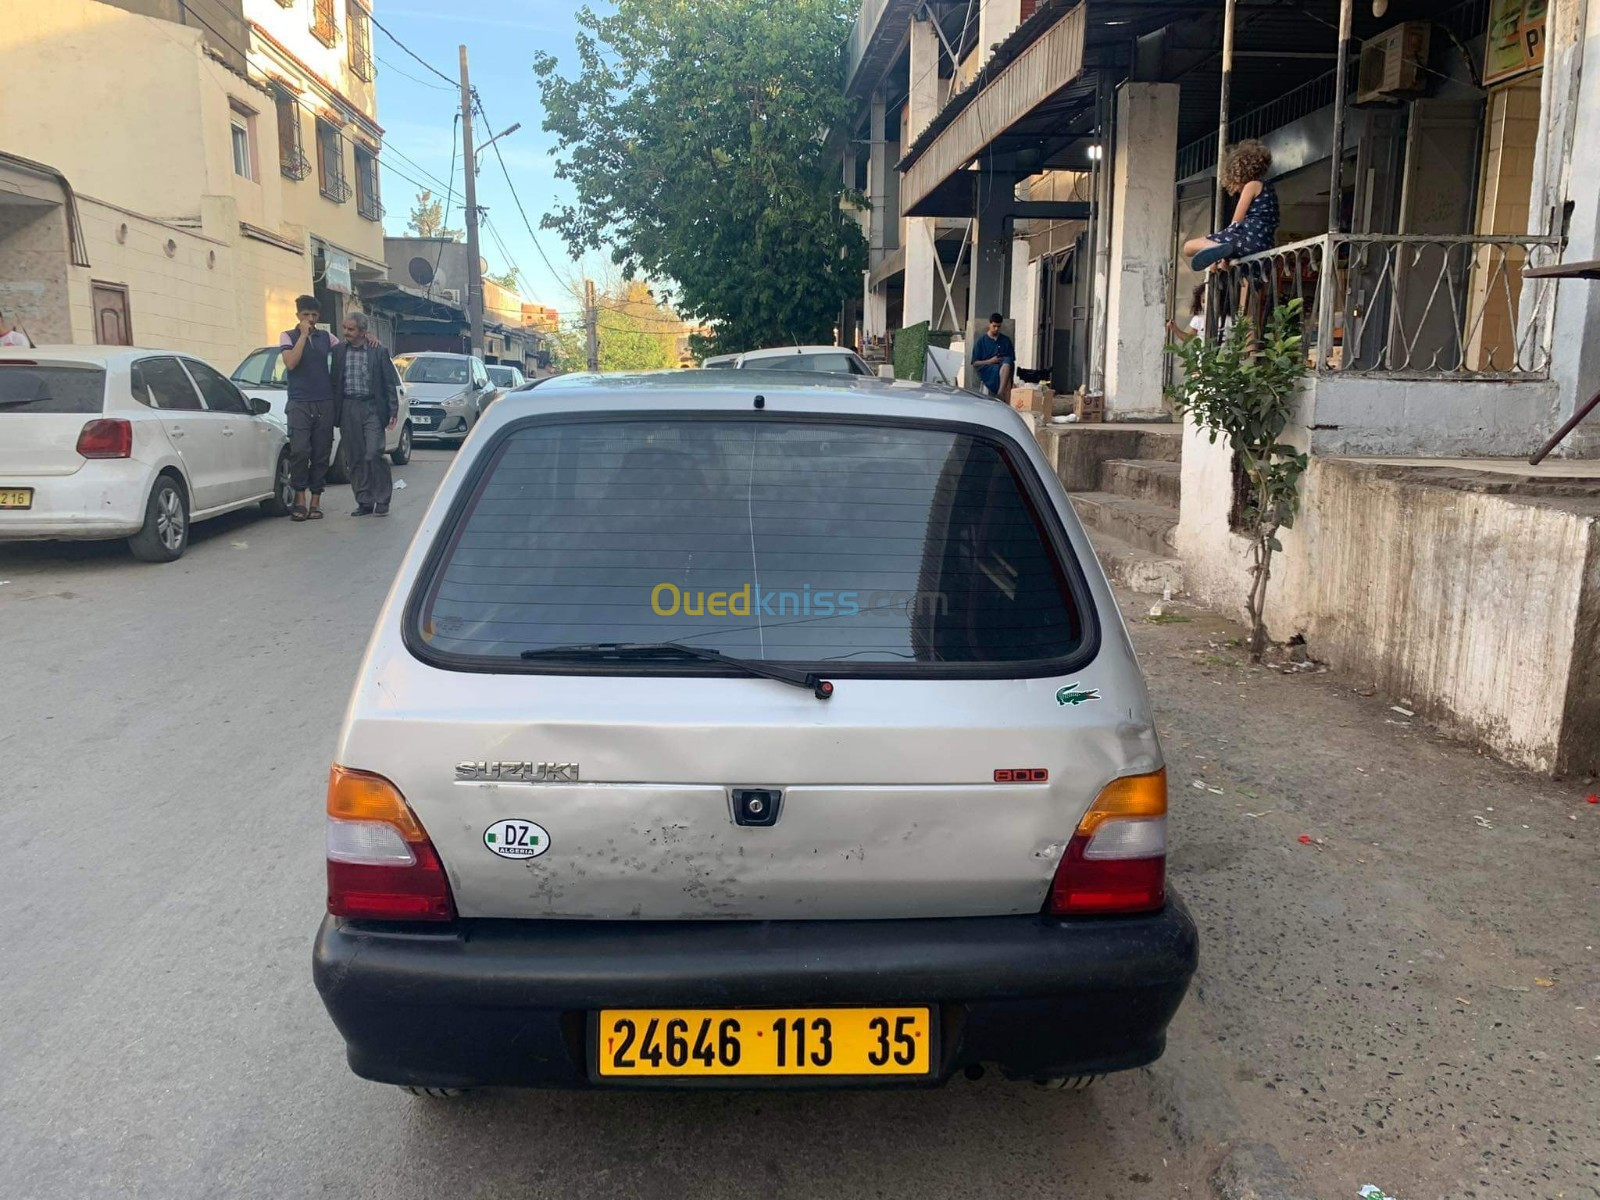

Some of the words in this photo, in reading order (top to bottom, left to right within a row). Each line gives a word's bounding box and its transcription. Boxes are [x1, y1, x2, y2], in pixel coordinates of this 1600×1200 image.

[11, 492, 24, 505] 16
[455, 761, 579, 780] SUZUKI
[994, 769, 1049, 783] 800
[505, 824, 529, 846] DZ
[613, 1017, 742, 1068] 24646
[772, 1017, 833, 1067] 113
[868, 1016, 917, 1067] 35
